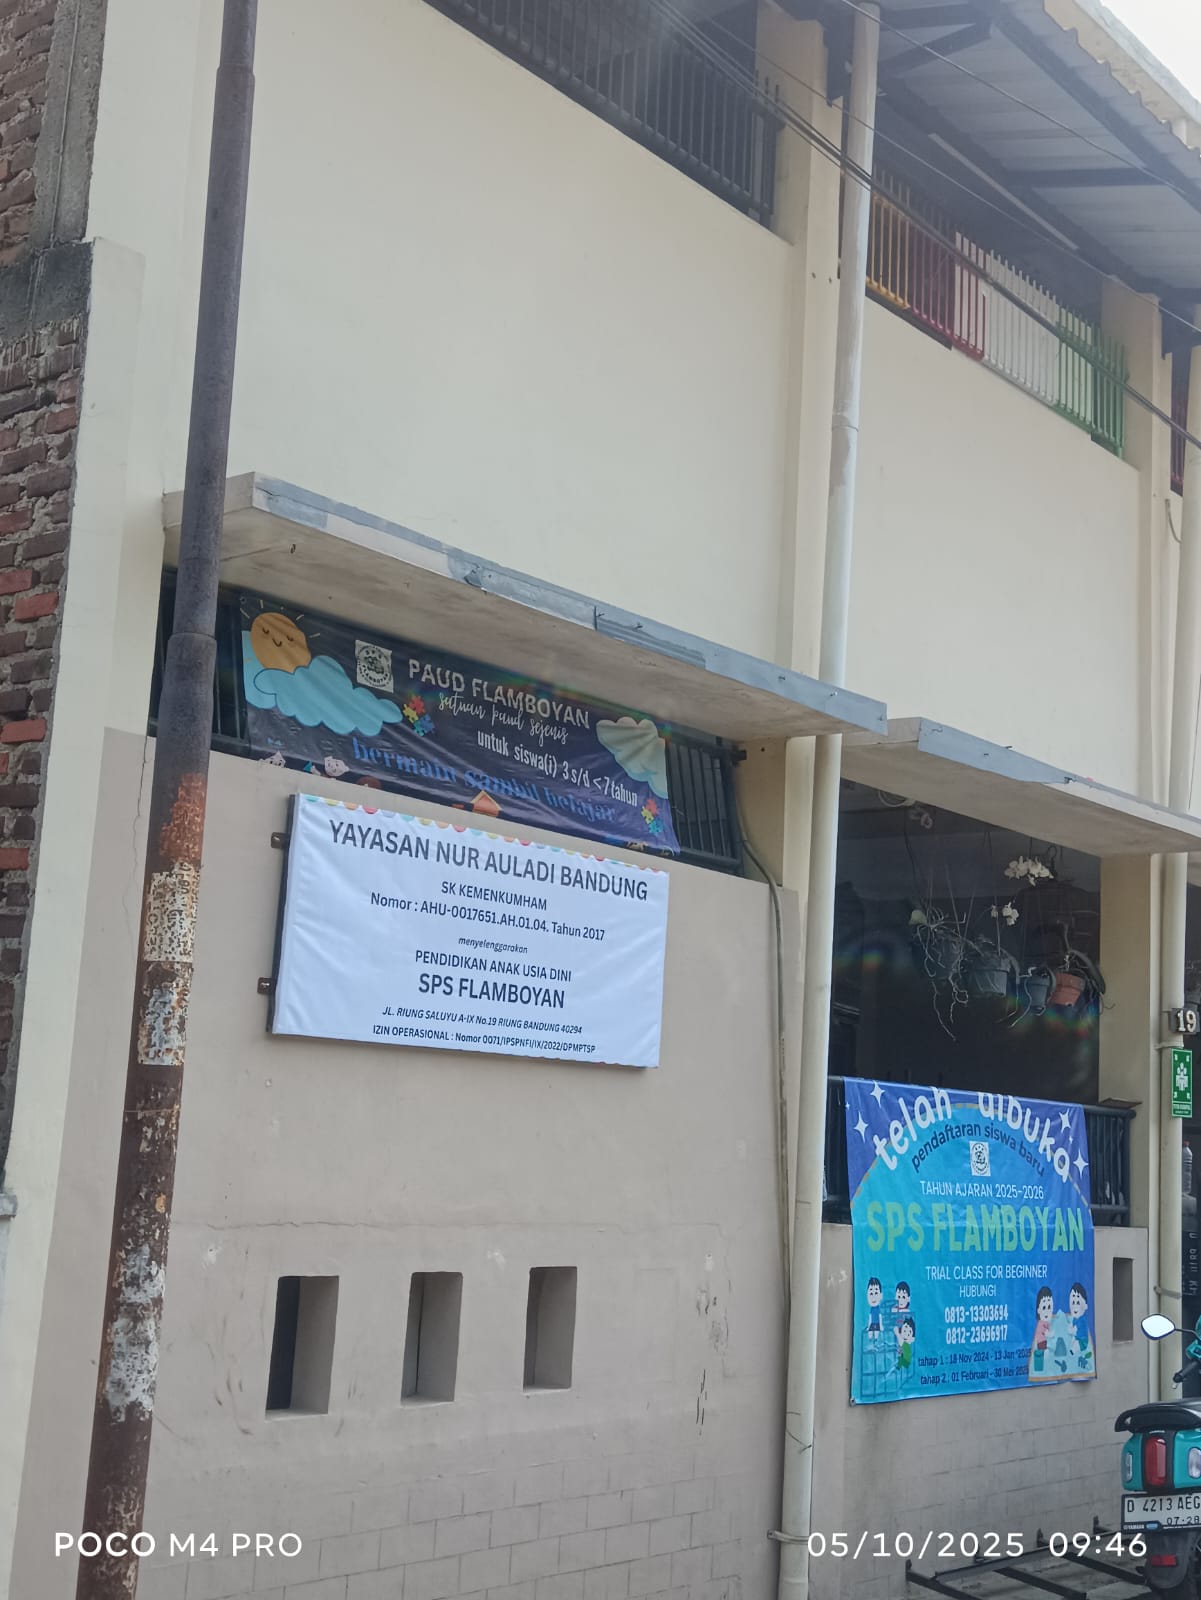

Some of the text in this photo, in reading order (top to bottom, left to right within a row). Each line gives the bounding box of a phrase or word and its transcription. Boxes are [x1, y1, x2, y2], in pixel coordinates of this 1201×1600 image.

[408, 658, 590, 729] PAUD FLAMBOYAN
[438, 691, 569, 745] satuan paud sejenis
[351, 737, 457, 784] bermain
[464, 768, 541, 801] sambil
[477, 729, 509, 755] untuk
[514, 744, 557, 779] siswa(i)
[329, 819, 648, 901] YAYASAN NUR AULADI BANDUNG
[441, 881, 548, 911] SK KEMENKUMHAM
[371, 893, 412, 912] Nomor
[420, 900, 549, 933] AHU-0017651.AH.01.04.
[551, 921, 580, 938] Tahun
[582, 926, 605, 941] 2017
[458, 936, 528, 955] menyelenggarakan
[415, 950, 572, 982] PENDIDIKAN ANAK USIA DINI
[418, 973, 565, 1009] SPS FLAMBOYAN
[373, 1025, 389, 1036] IZIN
[391, 1027, 449, 1041] OPERASIONAL
[455, 1033, 481, 1044] Nomor
[382, 1006, 582, 1034] JL. RIUNG SALUYU A-IX No.19 RIUNG BANDUNG 40294
[1177, 1010, 1196, 1032] 19
[873, 1086, 1071, 1182] telah dibuka
[912, 1122, 1045, 1178] pendaftaran siswa baru
[920, 1180, 1044, 1200] TAHUN AJARAN 2025-2026
[866, 1202, 1085, 1252] SPS FLAMBOYAN
[926, 1265, 1047, 1280] TRIAL CLASS FOR BEGINNER
[960, 1285, 996, 1298] HUBUNGI
[918, 1356, 938, 1368] tahap
[940, 1356, 944, 1365] 1
[959, 1354, 972, 1363] Nov
[974, 1352, 989, 1362] 2024
[994, 1351, 1001, 1360] 13
[1002, 1350, 1015, 1359] Jan
[921, 1375, 940, 1386] tahap
[942, 1374, 946, 1383] 2
[952, 1372, 959, 1381] 01
[994, 1368, 1001, 1377] 30
[1127, 1496, 1200, 1512] D 4213 AEG
